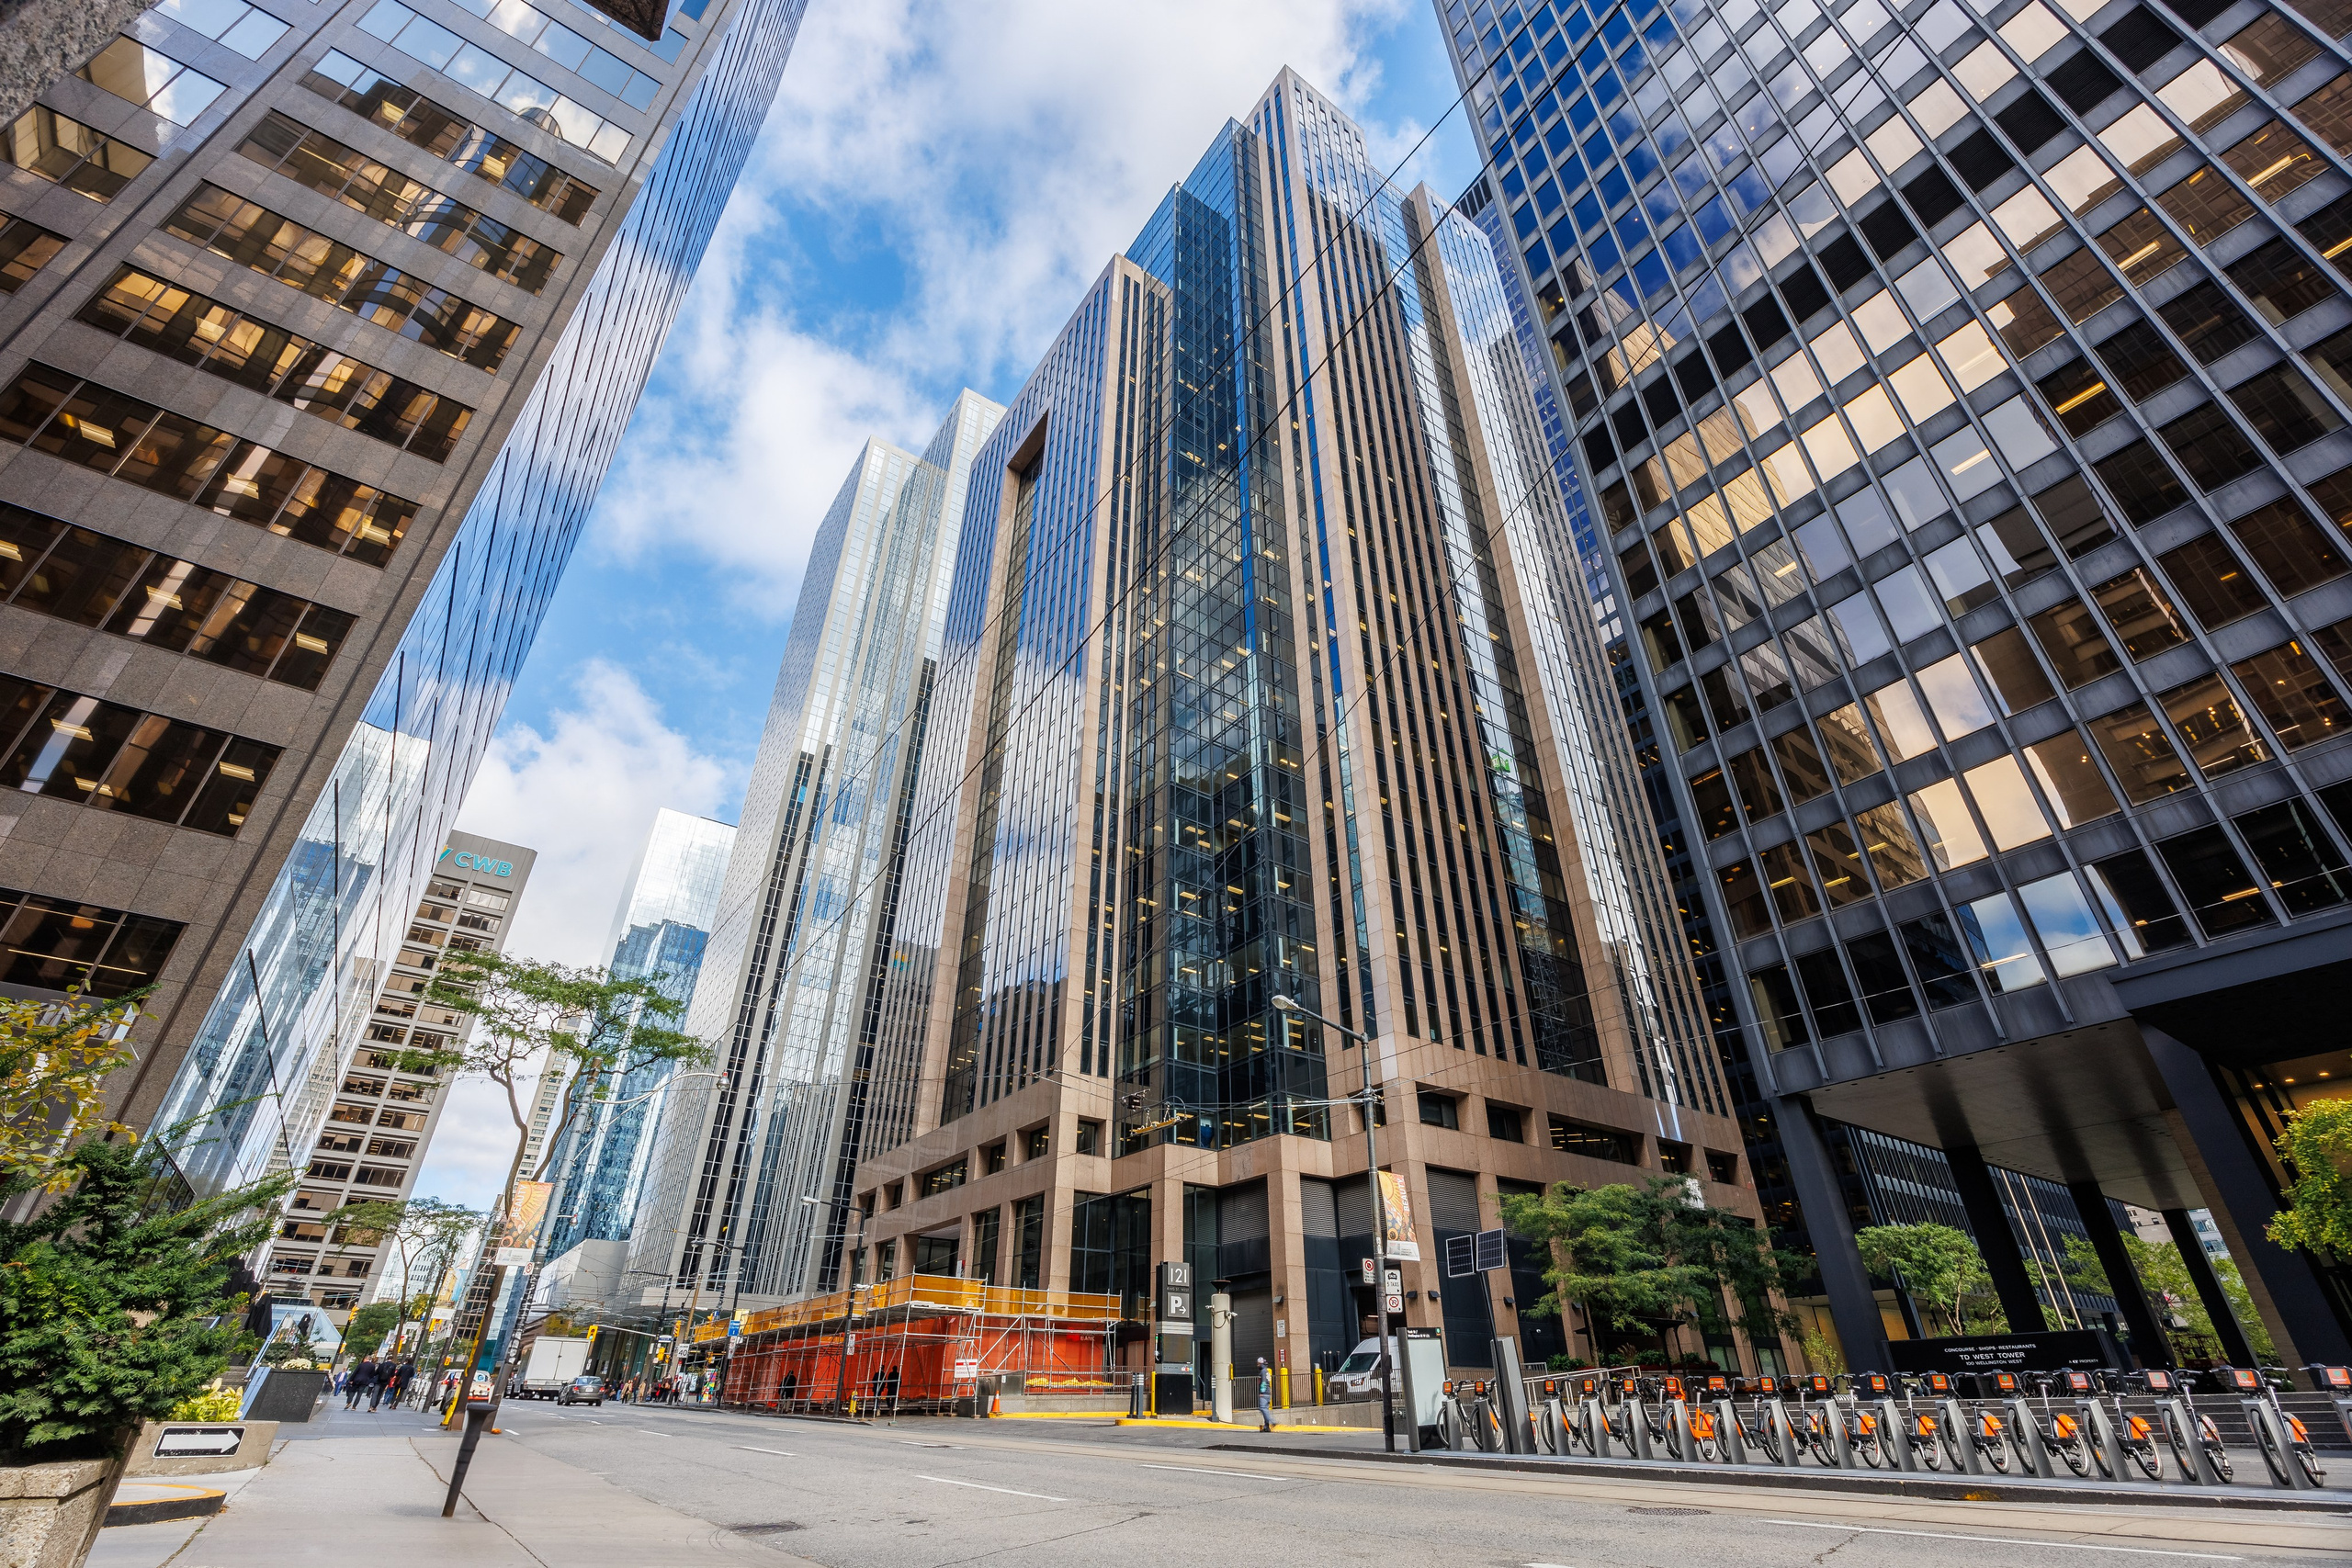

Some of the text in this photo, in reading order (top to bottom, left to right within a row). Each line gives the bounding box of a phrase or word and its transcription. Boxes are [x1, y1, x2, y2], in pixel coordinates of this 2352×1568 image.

[455, 851, 513, 877] CWB
[511, 1184, 527, 1218] BEAUTY
[1397, 1178, 1410, 1212] BEAUTY
[1170, 1268, 1187, 1283] 121
[1170, 1295, 1182, 1314] P
